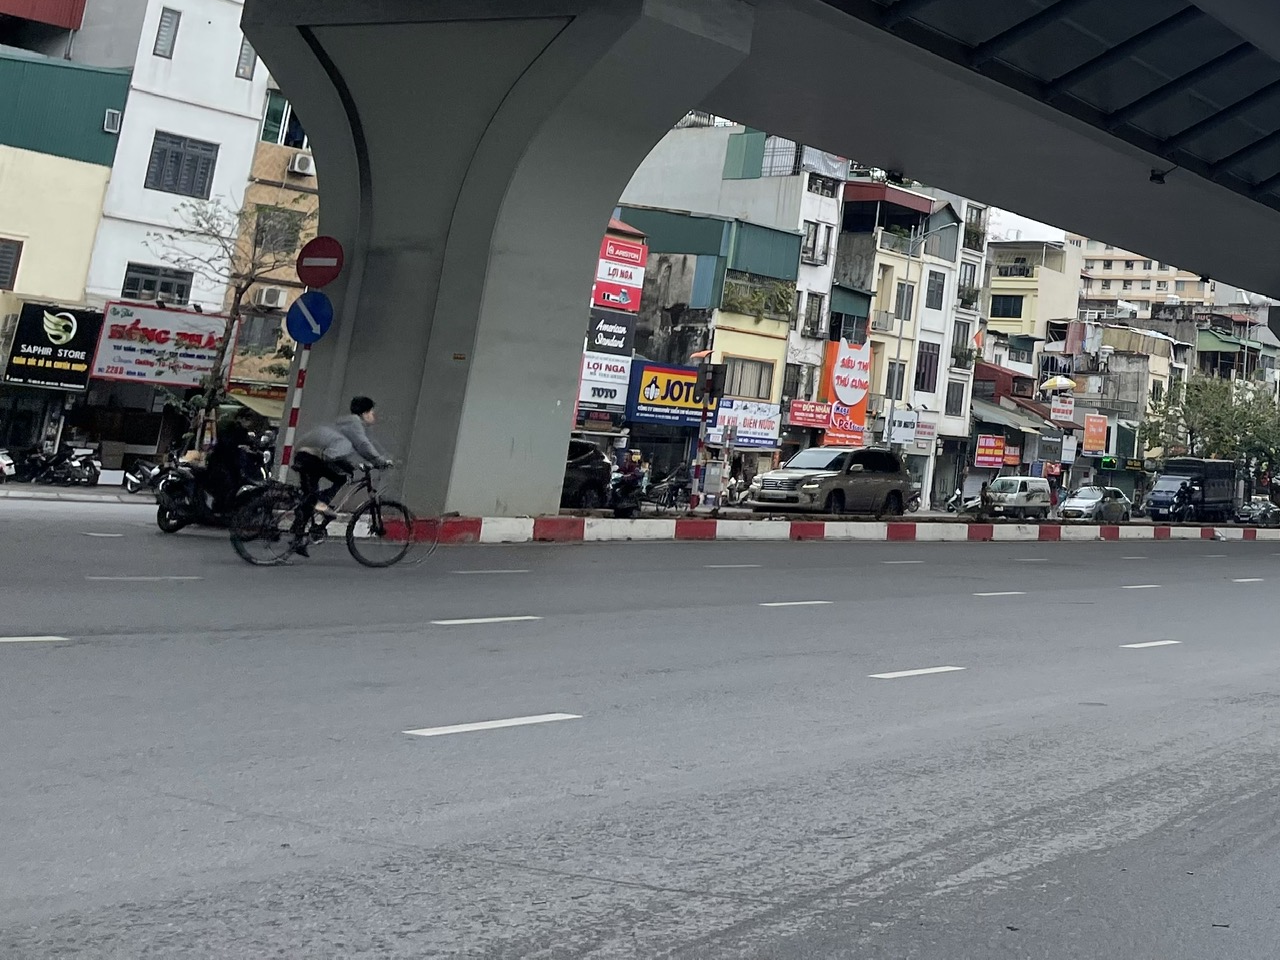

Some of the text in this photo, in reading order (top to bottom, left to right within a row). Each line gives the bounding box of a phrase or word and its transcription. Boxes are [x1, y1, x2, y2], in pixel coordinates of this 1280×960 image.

[615, 249, 639, 260] ARISTON
[596, 319, 627, 334] American
[594, 332, 625, 348] Standard
[20, 344, 87, 360] SAPHIR STORE
[587, 361, 626, 374] LỢI NGA
[591, 387, 617, 399] TOTO
[661, 379, 714, 405] JOTU
